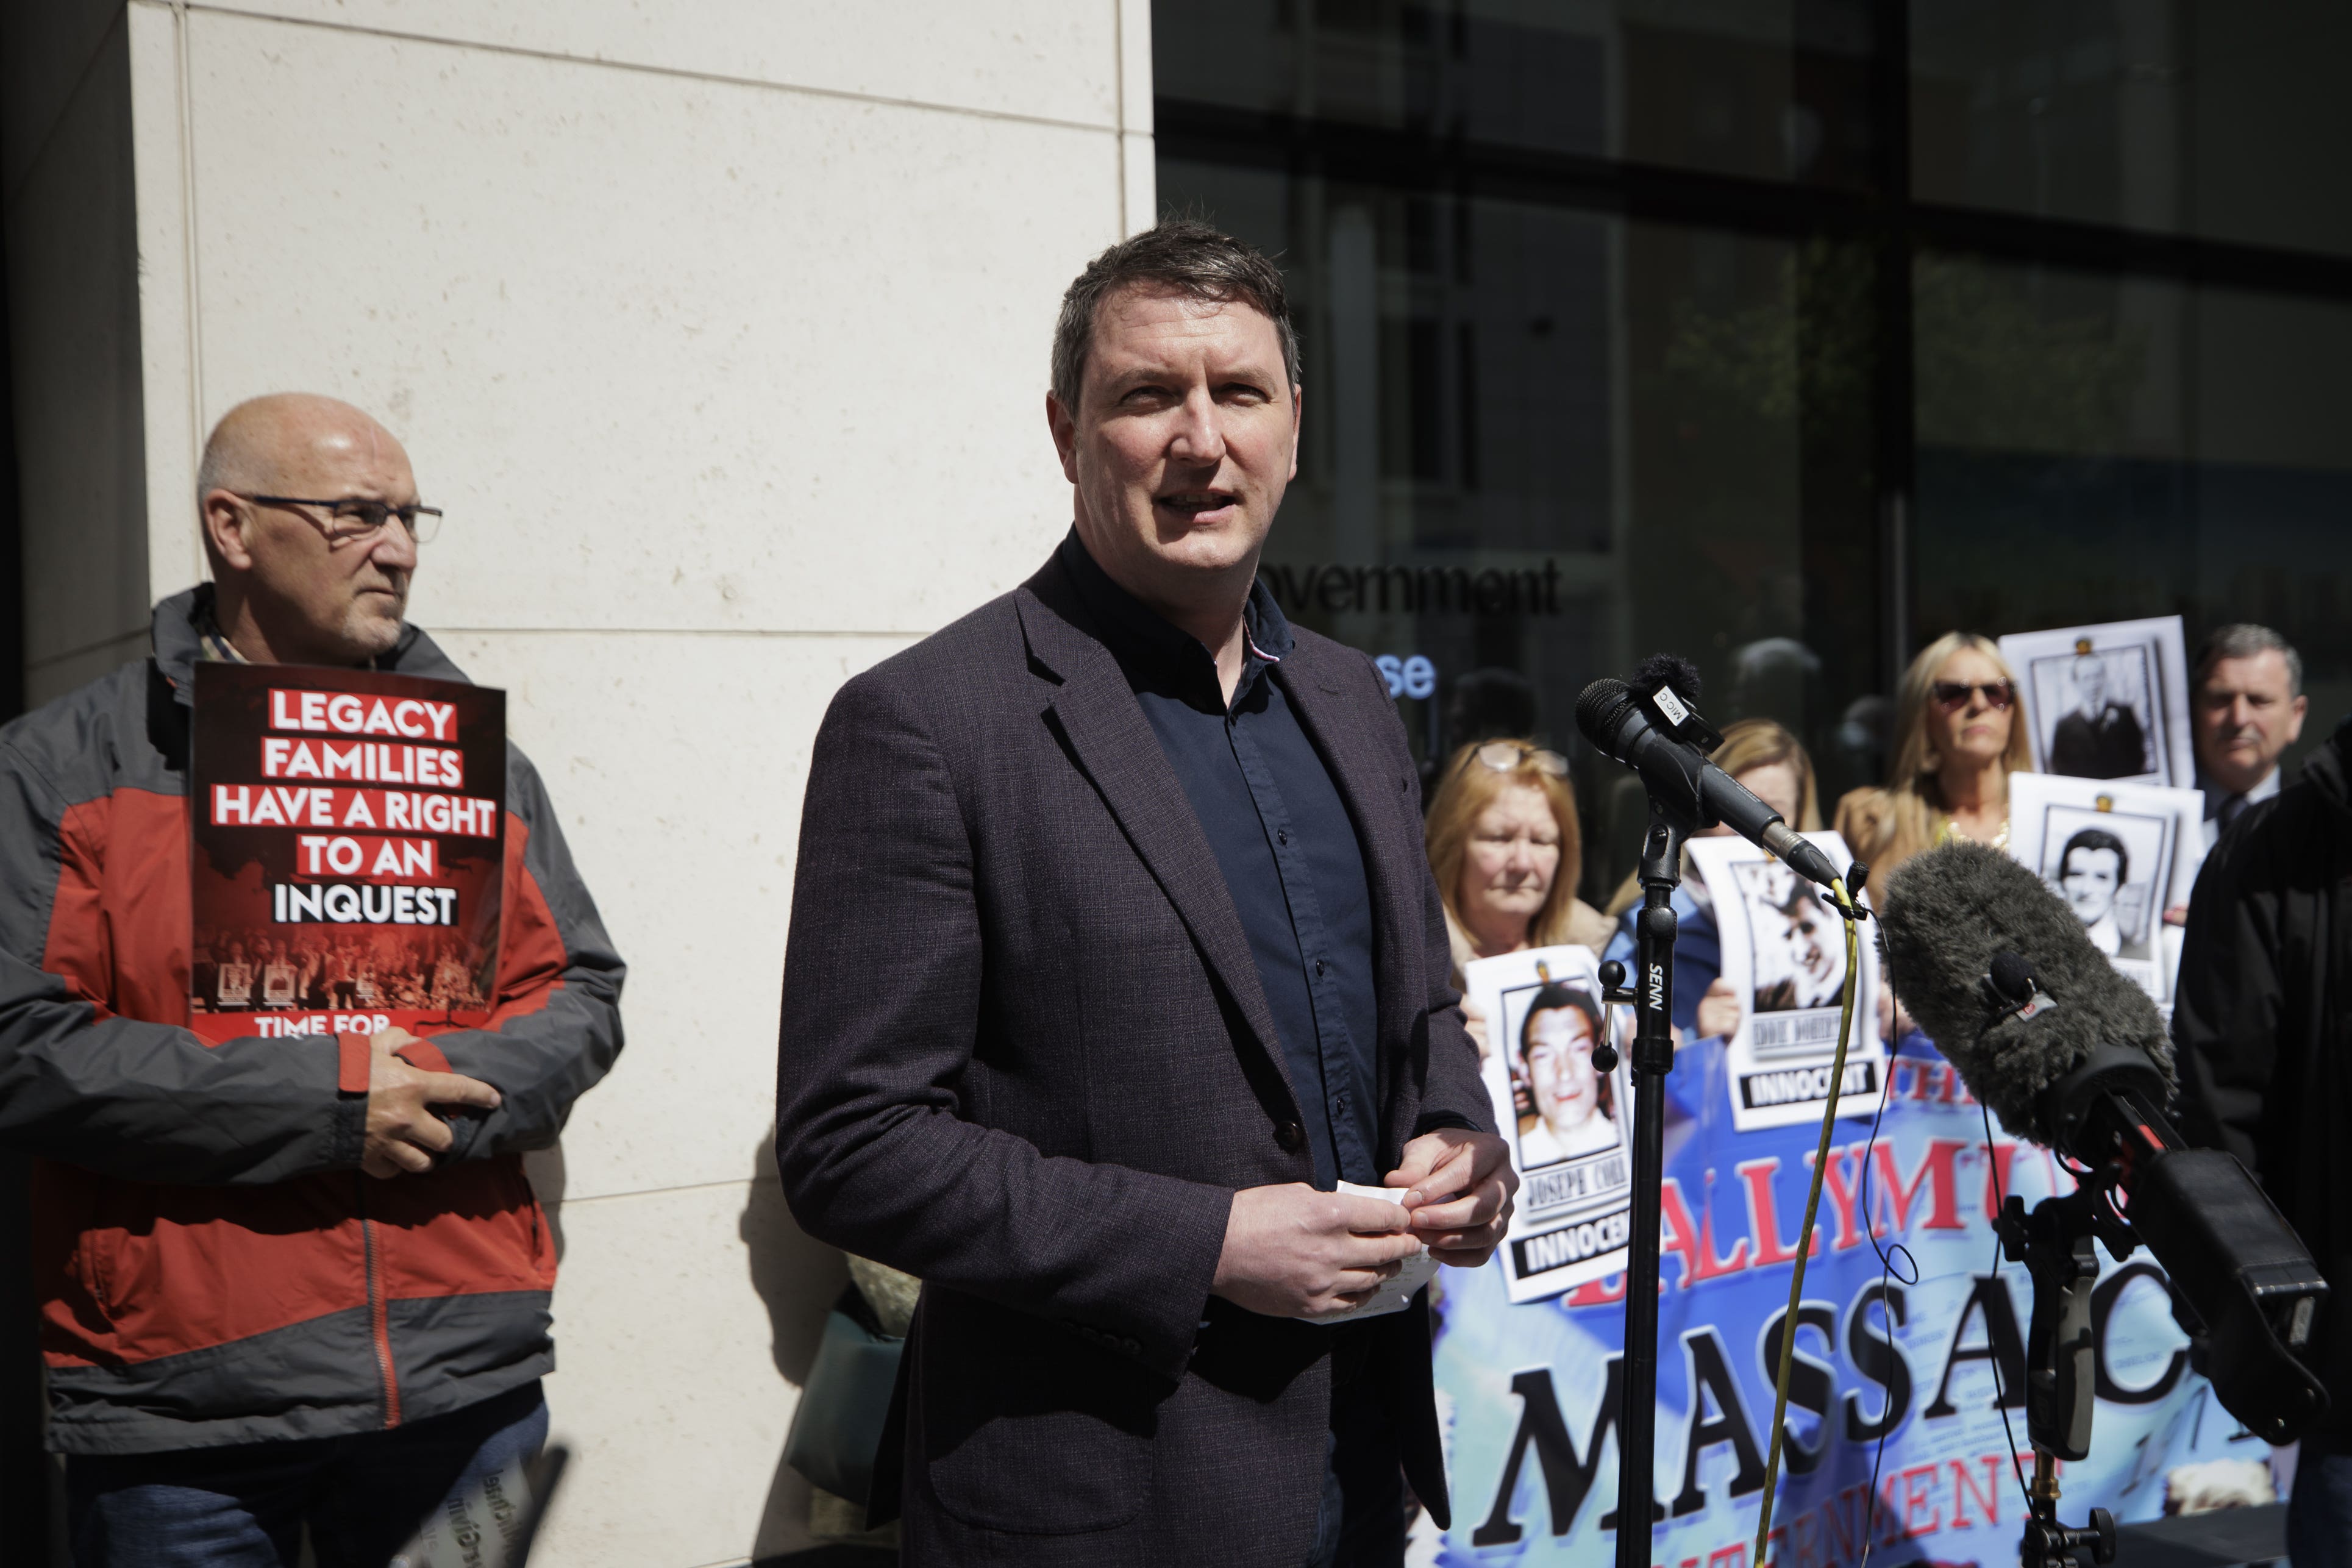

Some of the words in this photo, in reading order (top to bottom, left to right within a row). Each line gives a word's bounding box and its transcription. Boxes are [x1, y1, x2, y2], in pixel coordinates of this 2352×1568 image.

[273, 691, 455, 739] LEGACY
[1667, 701, 1683, 719] MIC
[265, 739, 462, 788] FAMILIES
[216, 785, 335, 825] HAVE
[343, 790, 377, 829] A
[385, 793, 496, 836] RIGHT
[301, 835, 364, 875] TO
[371, 839, 433, 878] AN
[275, 884, 457, 925] INQUEST
[1649, 963, 1663, 1011] SENN
[254, 1014, 327, 1040] TIME
[333, 1014, 390, 1036] FOR
[1749, 1063, 1868, 1108] INNOCNT
[1886, 1060, 1977, 1105] TH
[1527, 1167, 1588, 1206] JOSEPH
[1472, 1261, 2207, 1547] MASSAC
